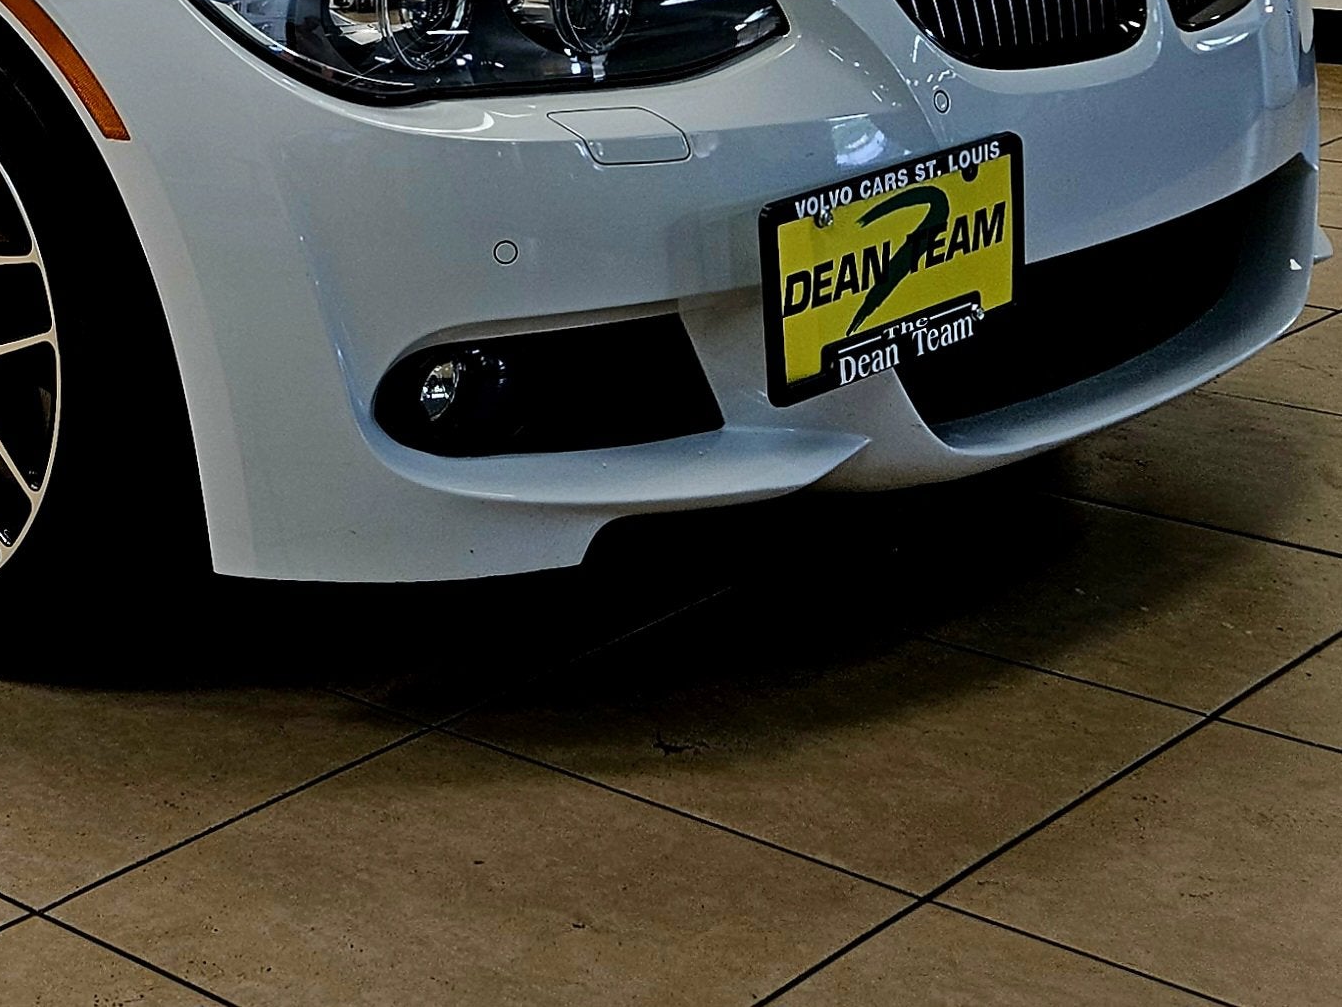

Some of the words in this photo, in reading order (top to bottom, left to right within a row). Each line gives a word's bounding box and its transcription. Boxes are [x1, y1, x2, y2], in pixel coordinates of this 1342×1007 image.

[794, 186, 853, 219] VOLVO
[859, 167, 909, 200] CARS
[948, 140, 1001, 173] LOUIS
[783, 240, 891, 316] DEAN
[906, 201, 1007, 275] TEAM
[883, 317, 929, 340] The
[838, 343, 900, 386] Dean
